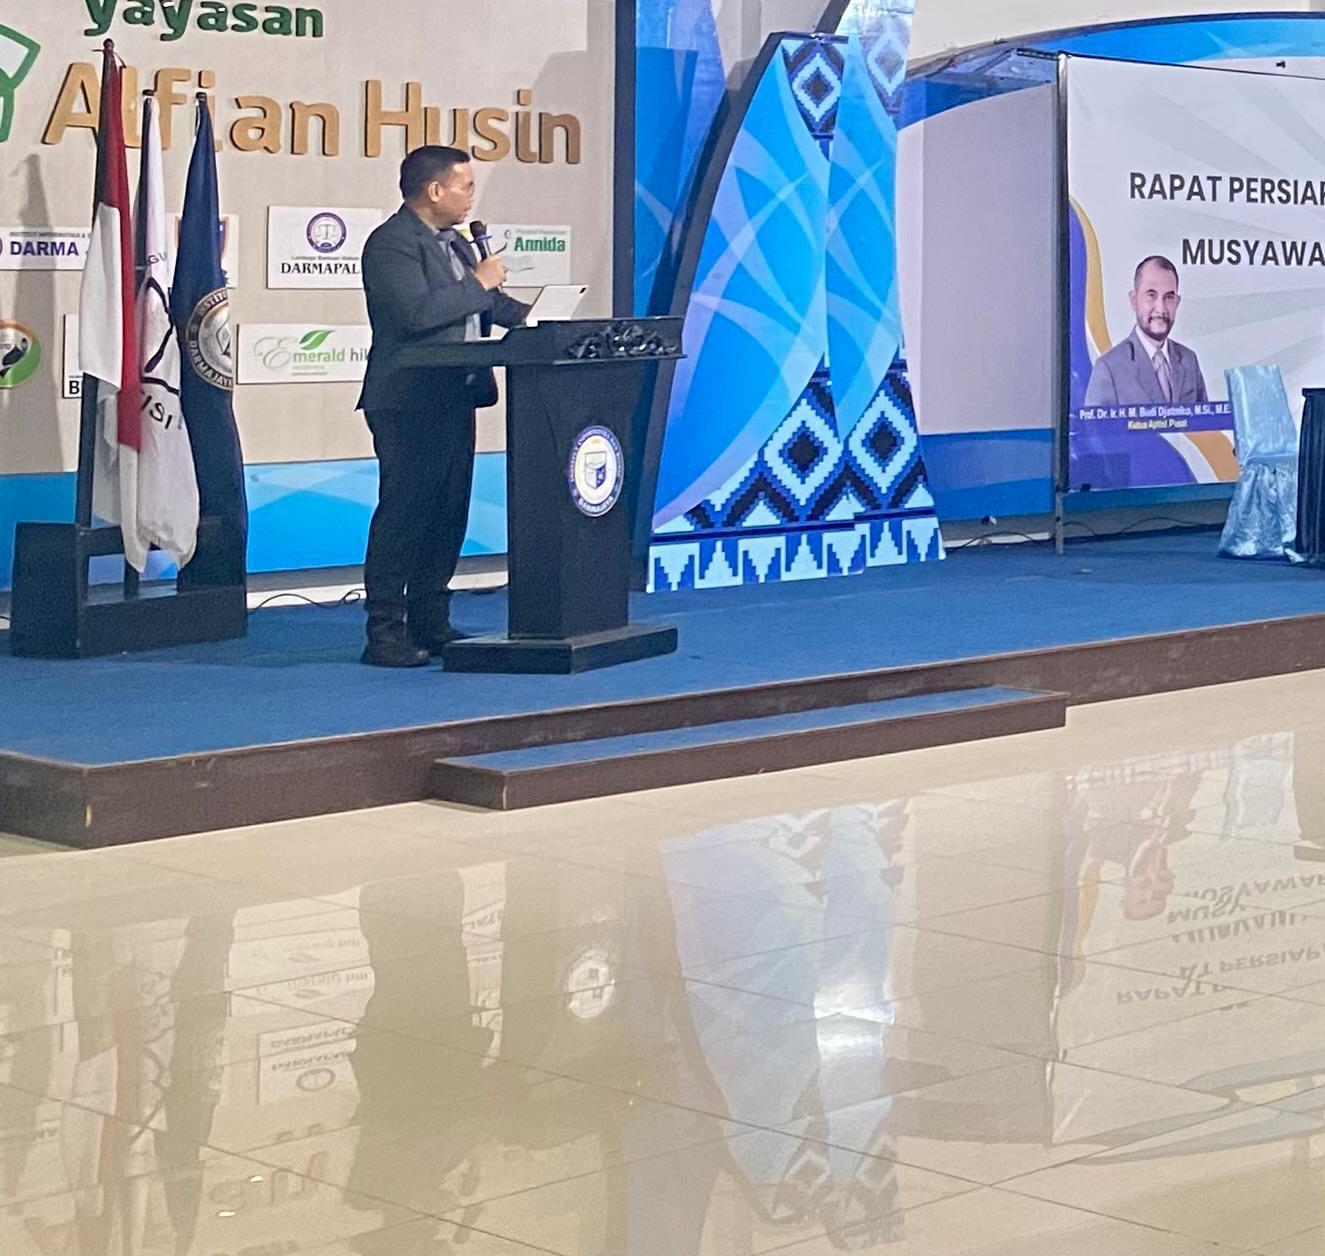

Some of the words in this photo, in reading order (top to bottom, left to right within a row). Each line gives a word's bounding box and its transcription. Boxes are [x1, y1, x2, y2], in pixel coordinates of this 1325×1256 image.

[364, 79, 582, 165] Husin
[1130, 172, 1222, 202] RAPAT
[10, 241, 79, 257] DARMA
[514, 236, 566, 252] Annida
[254, 336, 346, 370] Emerald
